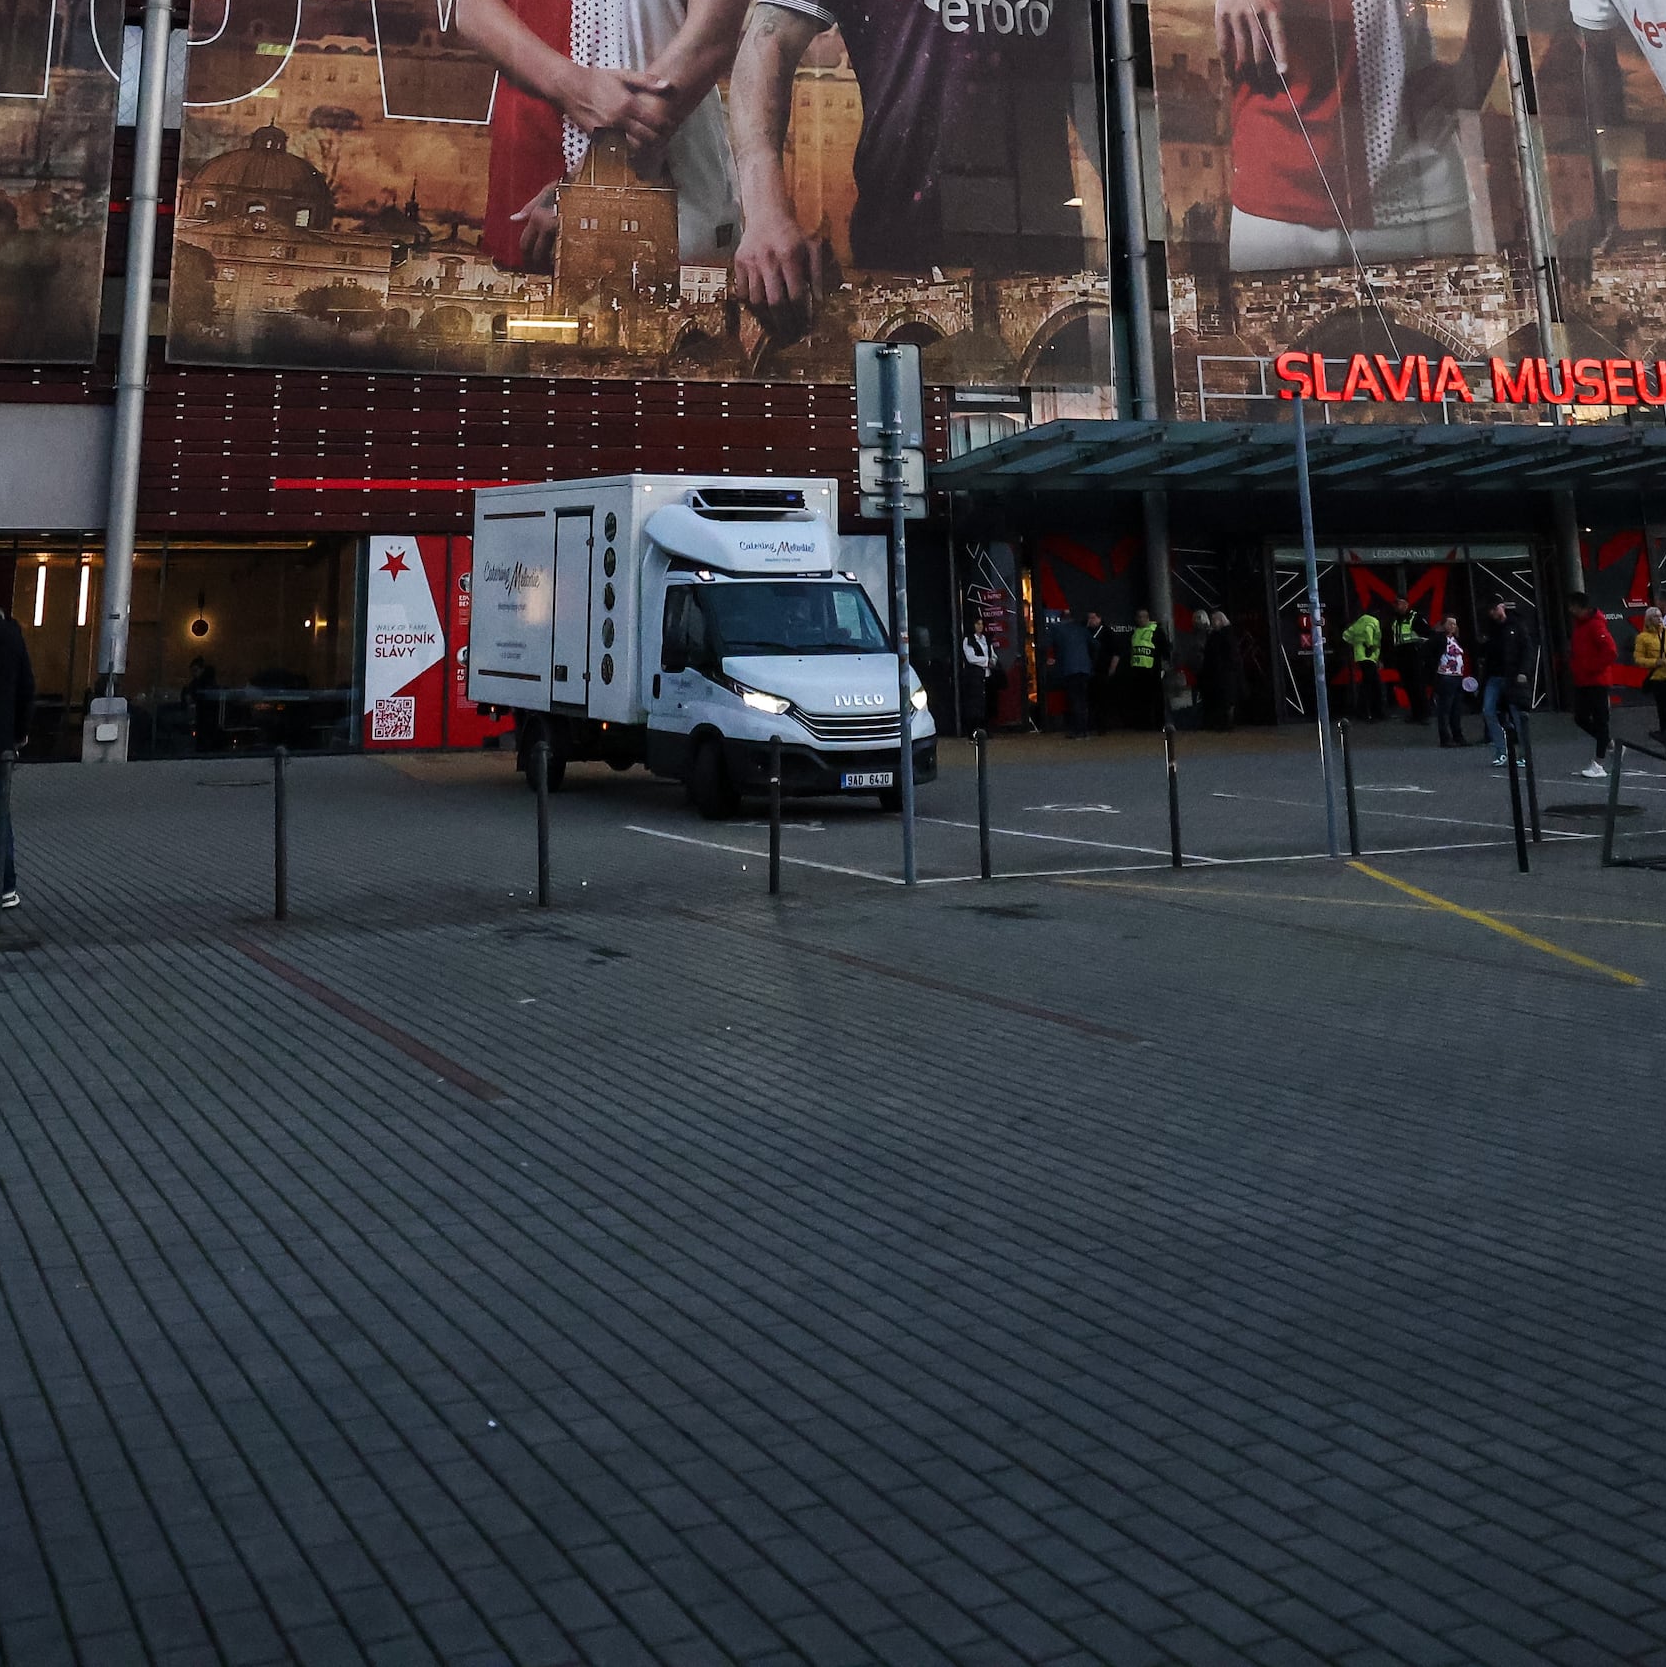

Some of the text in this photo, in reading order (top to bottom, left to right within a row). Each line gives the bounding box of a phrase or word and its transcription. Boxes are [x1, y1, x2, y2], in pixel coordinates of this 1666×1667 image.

[1274, 350, 1473, 404] SLAVIA
[375, 631, 436, 645] CHODNÍK
[374, 644, 417, 658] SLÁVY
[834, 693, 885, 707] IVECO
[847, 775, 864, 786] 9AD
